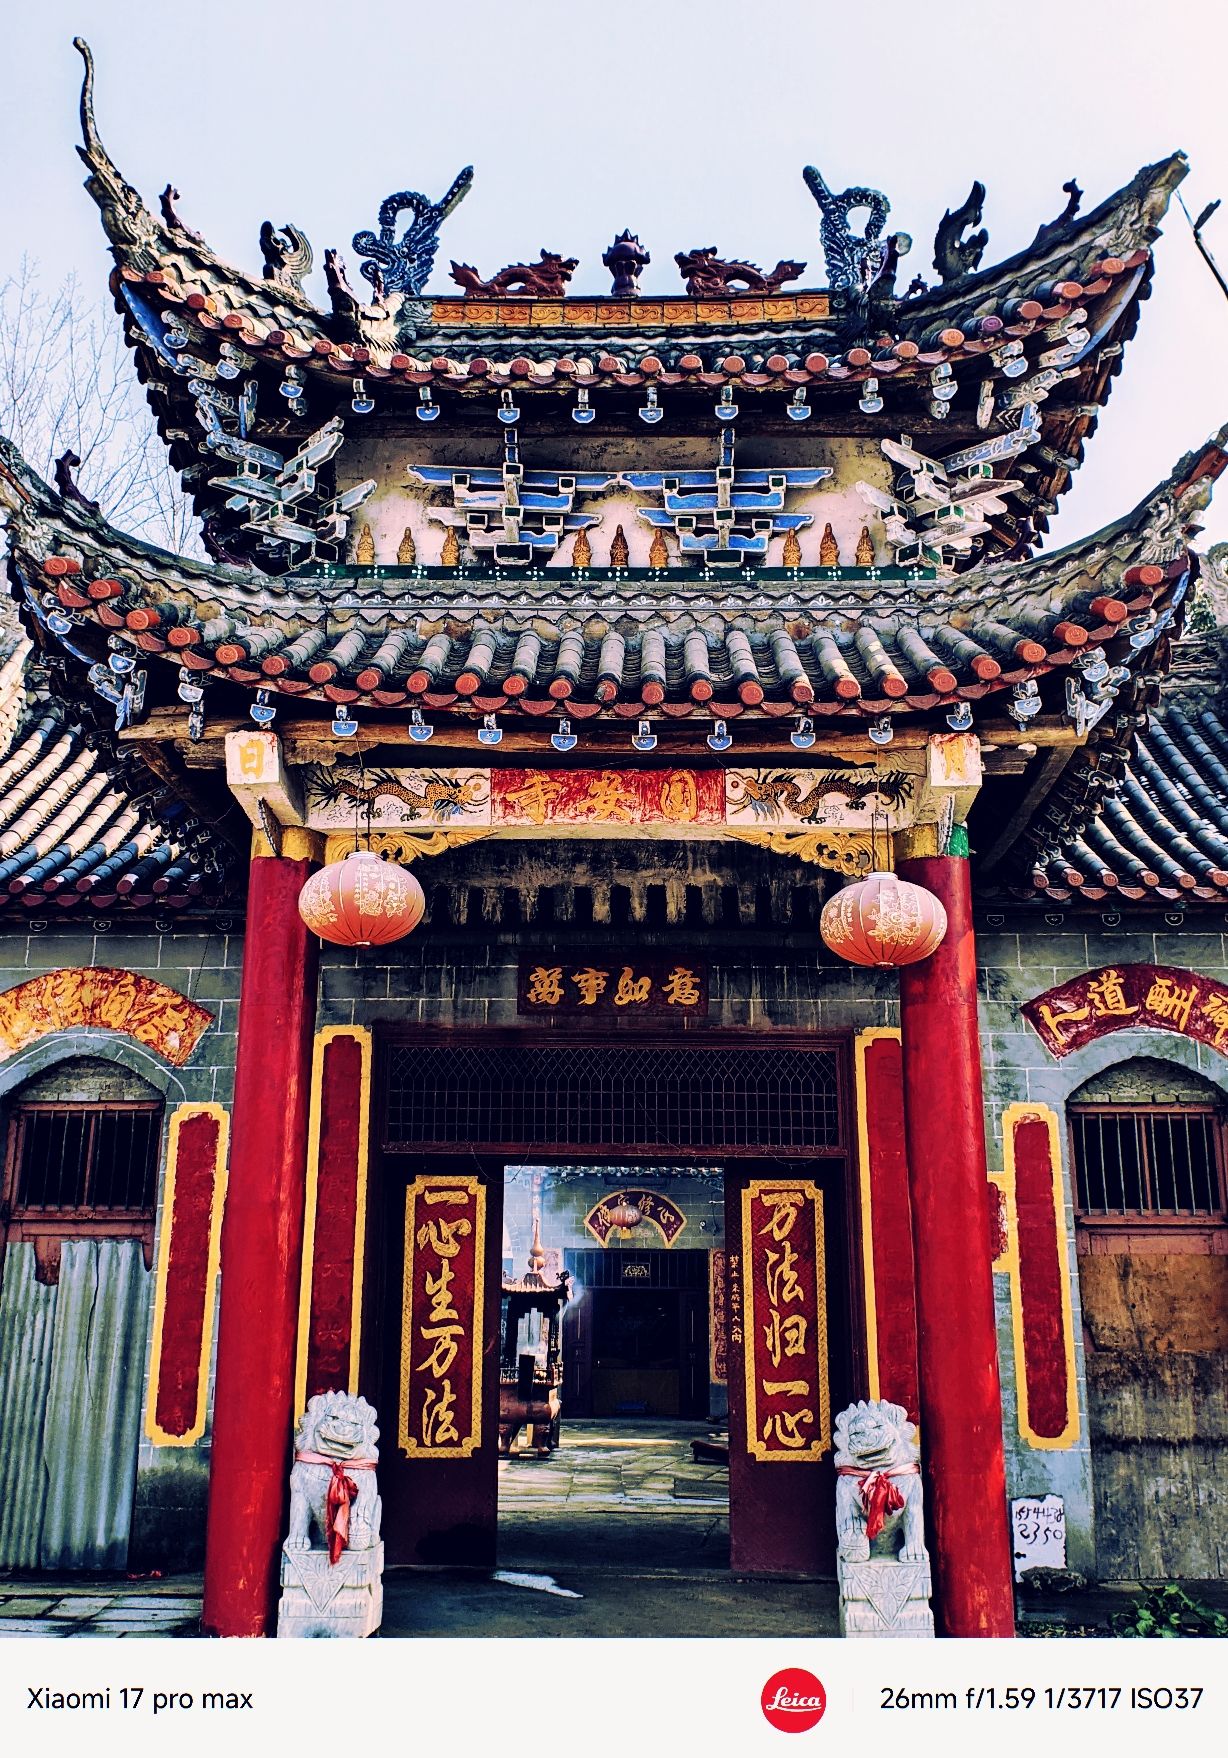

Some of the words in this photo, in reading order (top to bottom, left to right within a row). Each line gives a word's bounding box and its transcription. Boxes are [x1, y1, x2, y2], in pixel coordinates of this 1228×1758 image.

[239, 739, 265, 779] 日
[943, 736, 967, 780] 月
[415, 1187, 472, 1447] 一心生万法
[757, 1191, 814, 1448] 万法归一心
[1017, 1521, 1063, 1545] 2350
